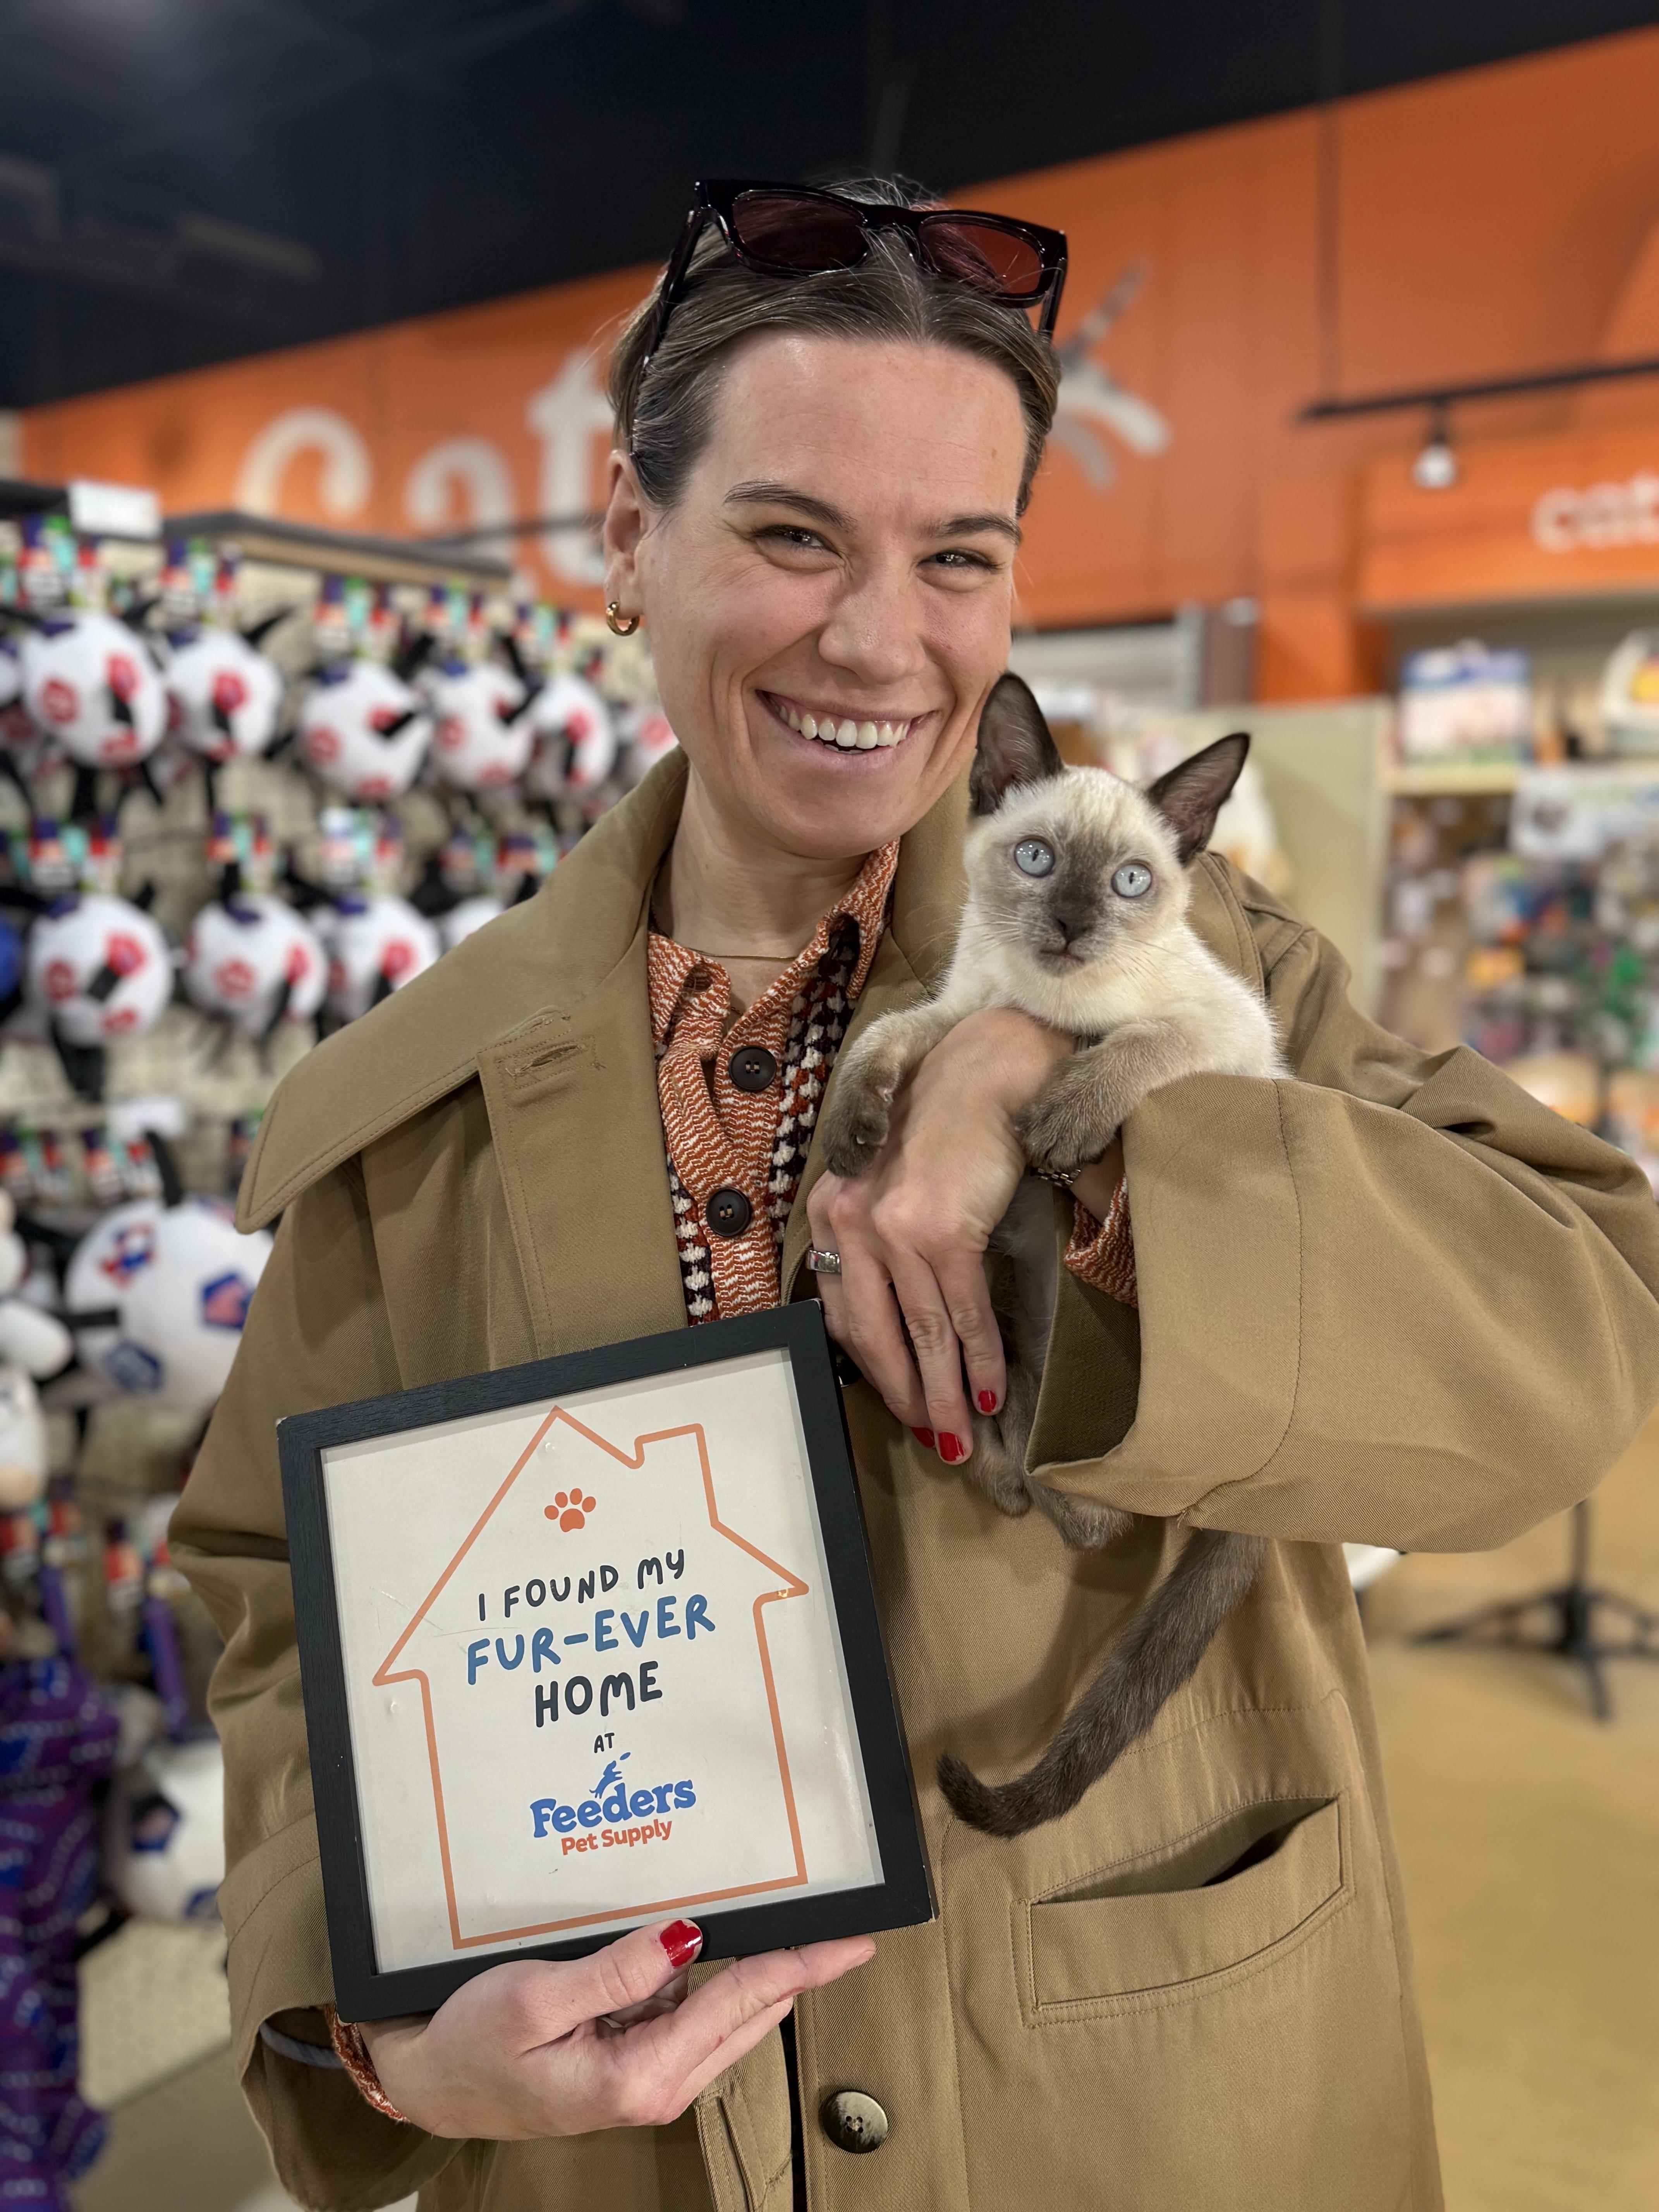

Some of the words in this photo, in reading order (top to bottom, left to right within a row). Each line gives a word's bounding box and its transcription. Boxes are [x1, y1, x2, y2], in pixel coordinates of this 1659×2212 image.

[479, 1593, 486, 1621] I
[504, 1565, 618, 1618] FOUND
[637, 1549, 684, 1589] MY
[468, 1594, 716, 1685] FUR-EVER
[535, 1661, 663, 1728] HOME
[594, 1732, 615, 1753] AT
[530, 1779, 696, 1838] Feeders
[561, 1833, 598, 1855] Pet
[601, 1819, 672, 1847] Supply
